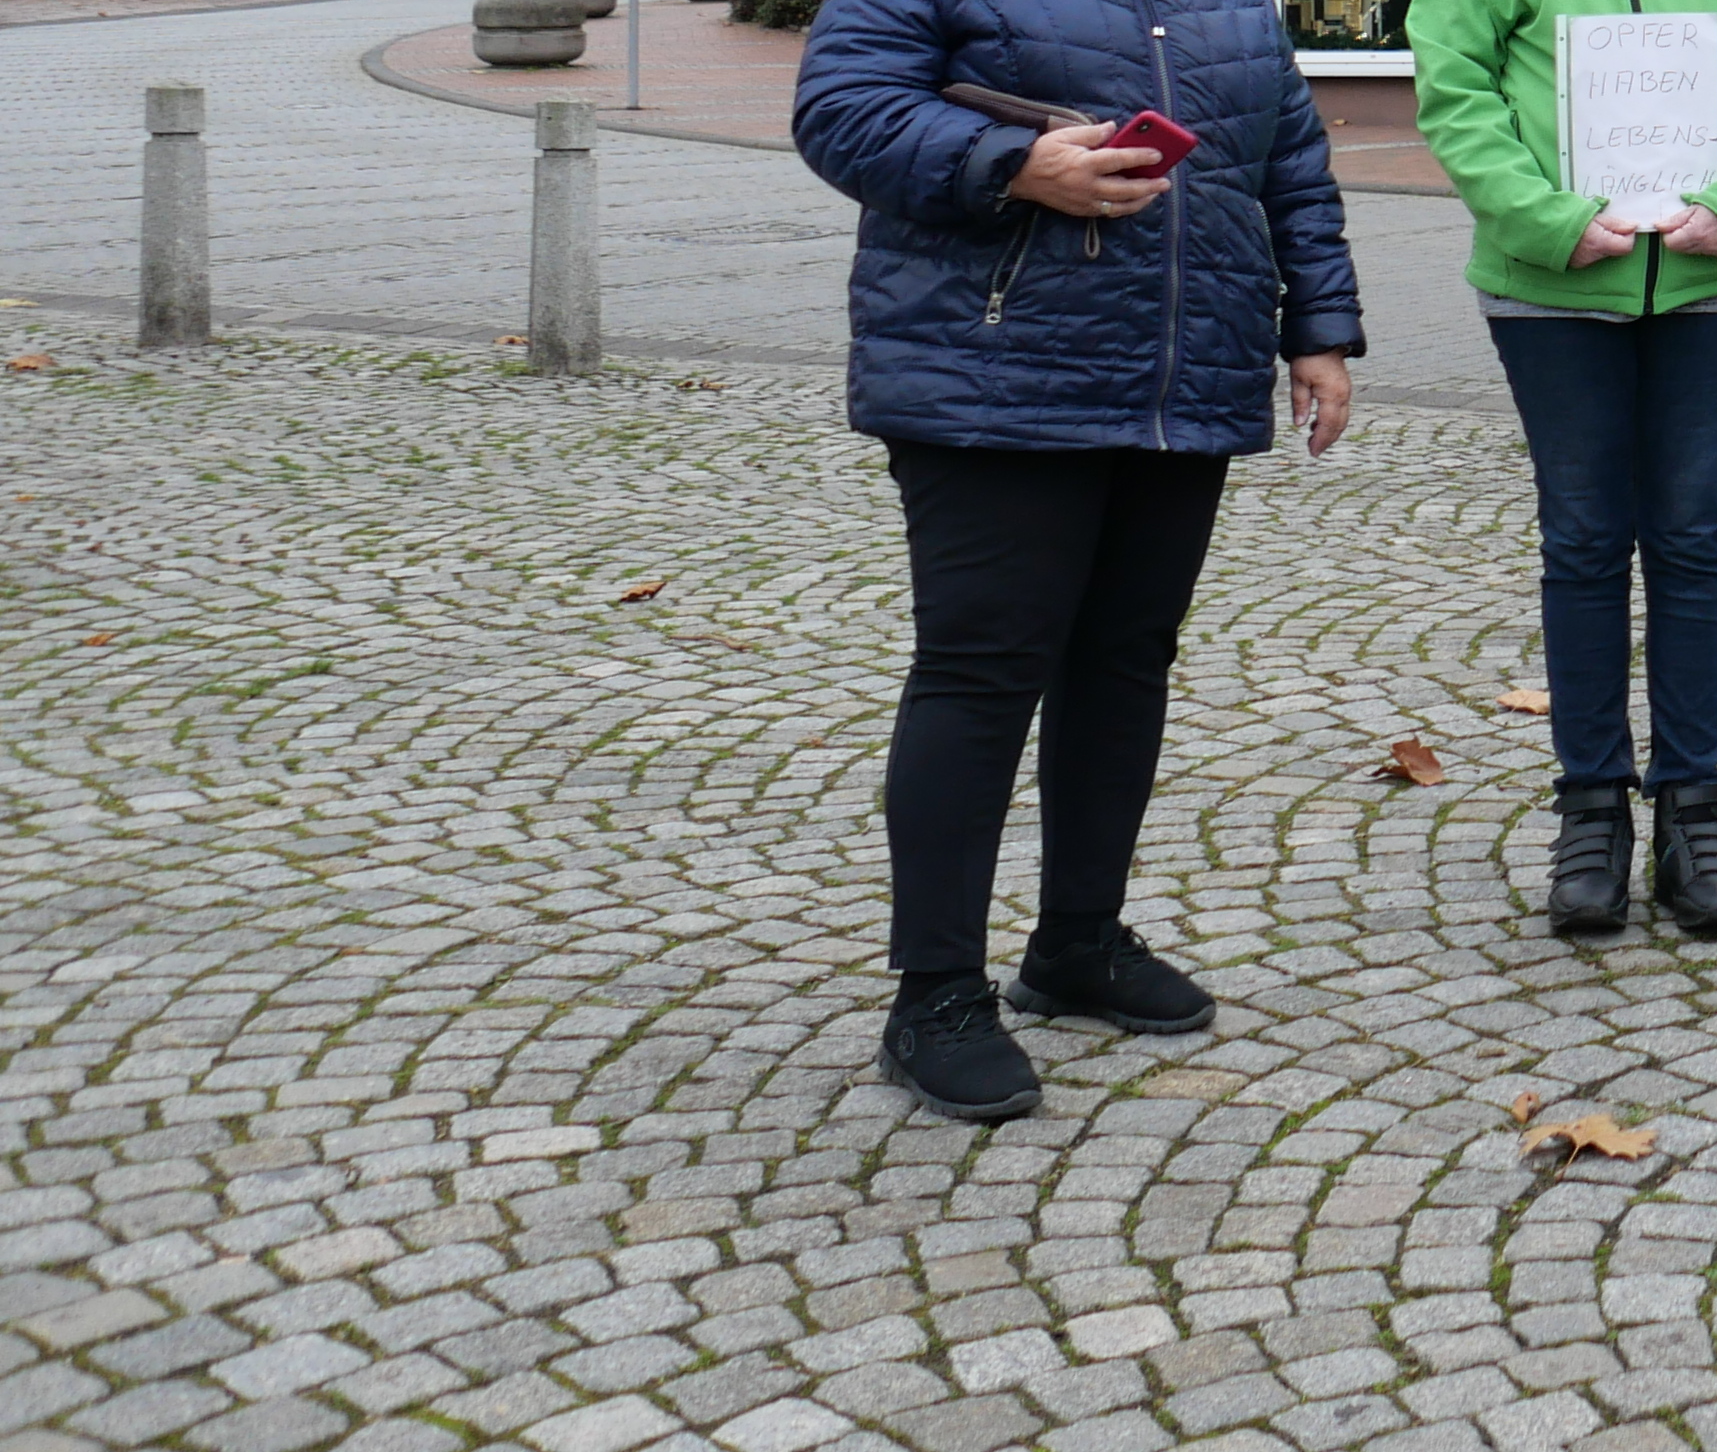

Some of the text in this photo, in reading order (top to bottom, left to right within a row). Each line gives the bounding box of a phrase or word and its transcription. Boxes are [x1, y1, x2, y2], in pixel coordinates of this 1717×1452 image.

[1587, 22, 1699, 50] OPFER
[1588, 70, 1699, 99] HABEN
[1582, 164, 1717, 199] LÄNGLICH
